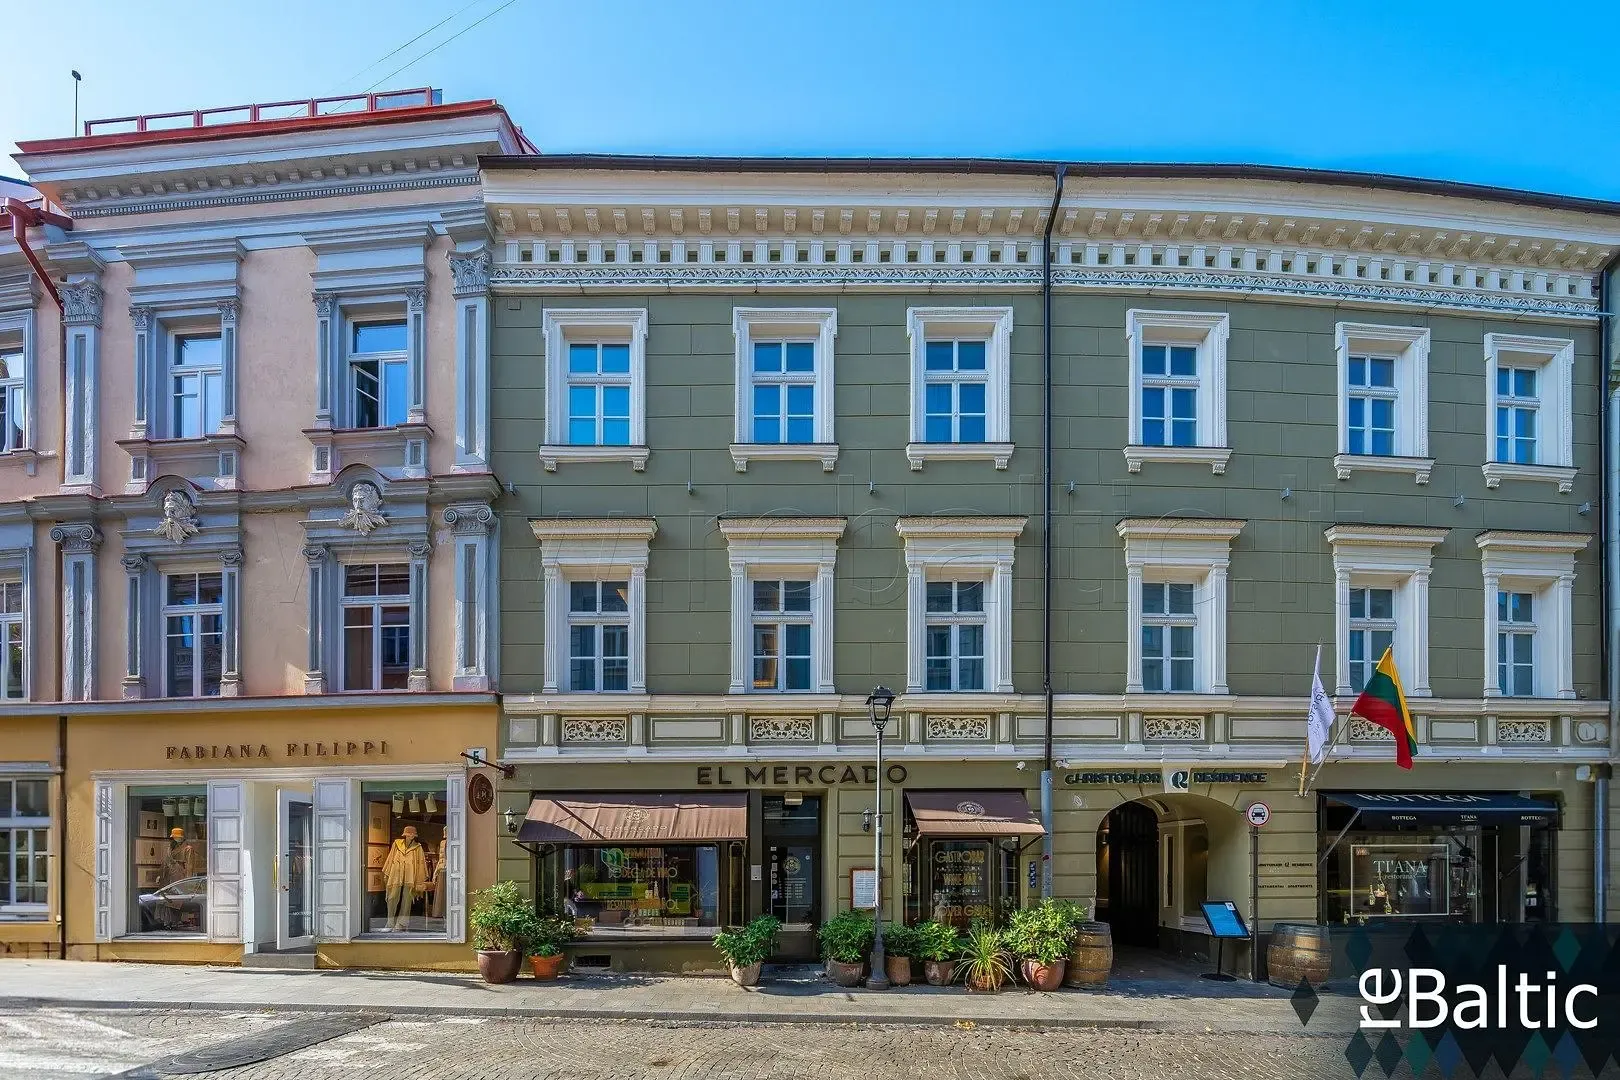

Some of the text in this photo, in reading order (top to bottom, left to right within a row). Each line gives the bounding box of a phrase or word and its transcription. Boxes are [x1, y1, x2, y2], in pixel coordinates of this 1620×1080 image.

[165, 740, 388, 760] FABIANA FILIPPI
[473, 750, 480, 765] 5
[697, 764, 908, 785] EL MERCADO
[1193, 772, 1267, 783] RESIDENCE
[1373, 860, 1428, 873] TI'ANA
